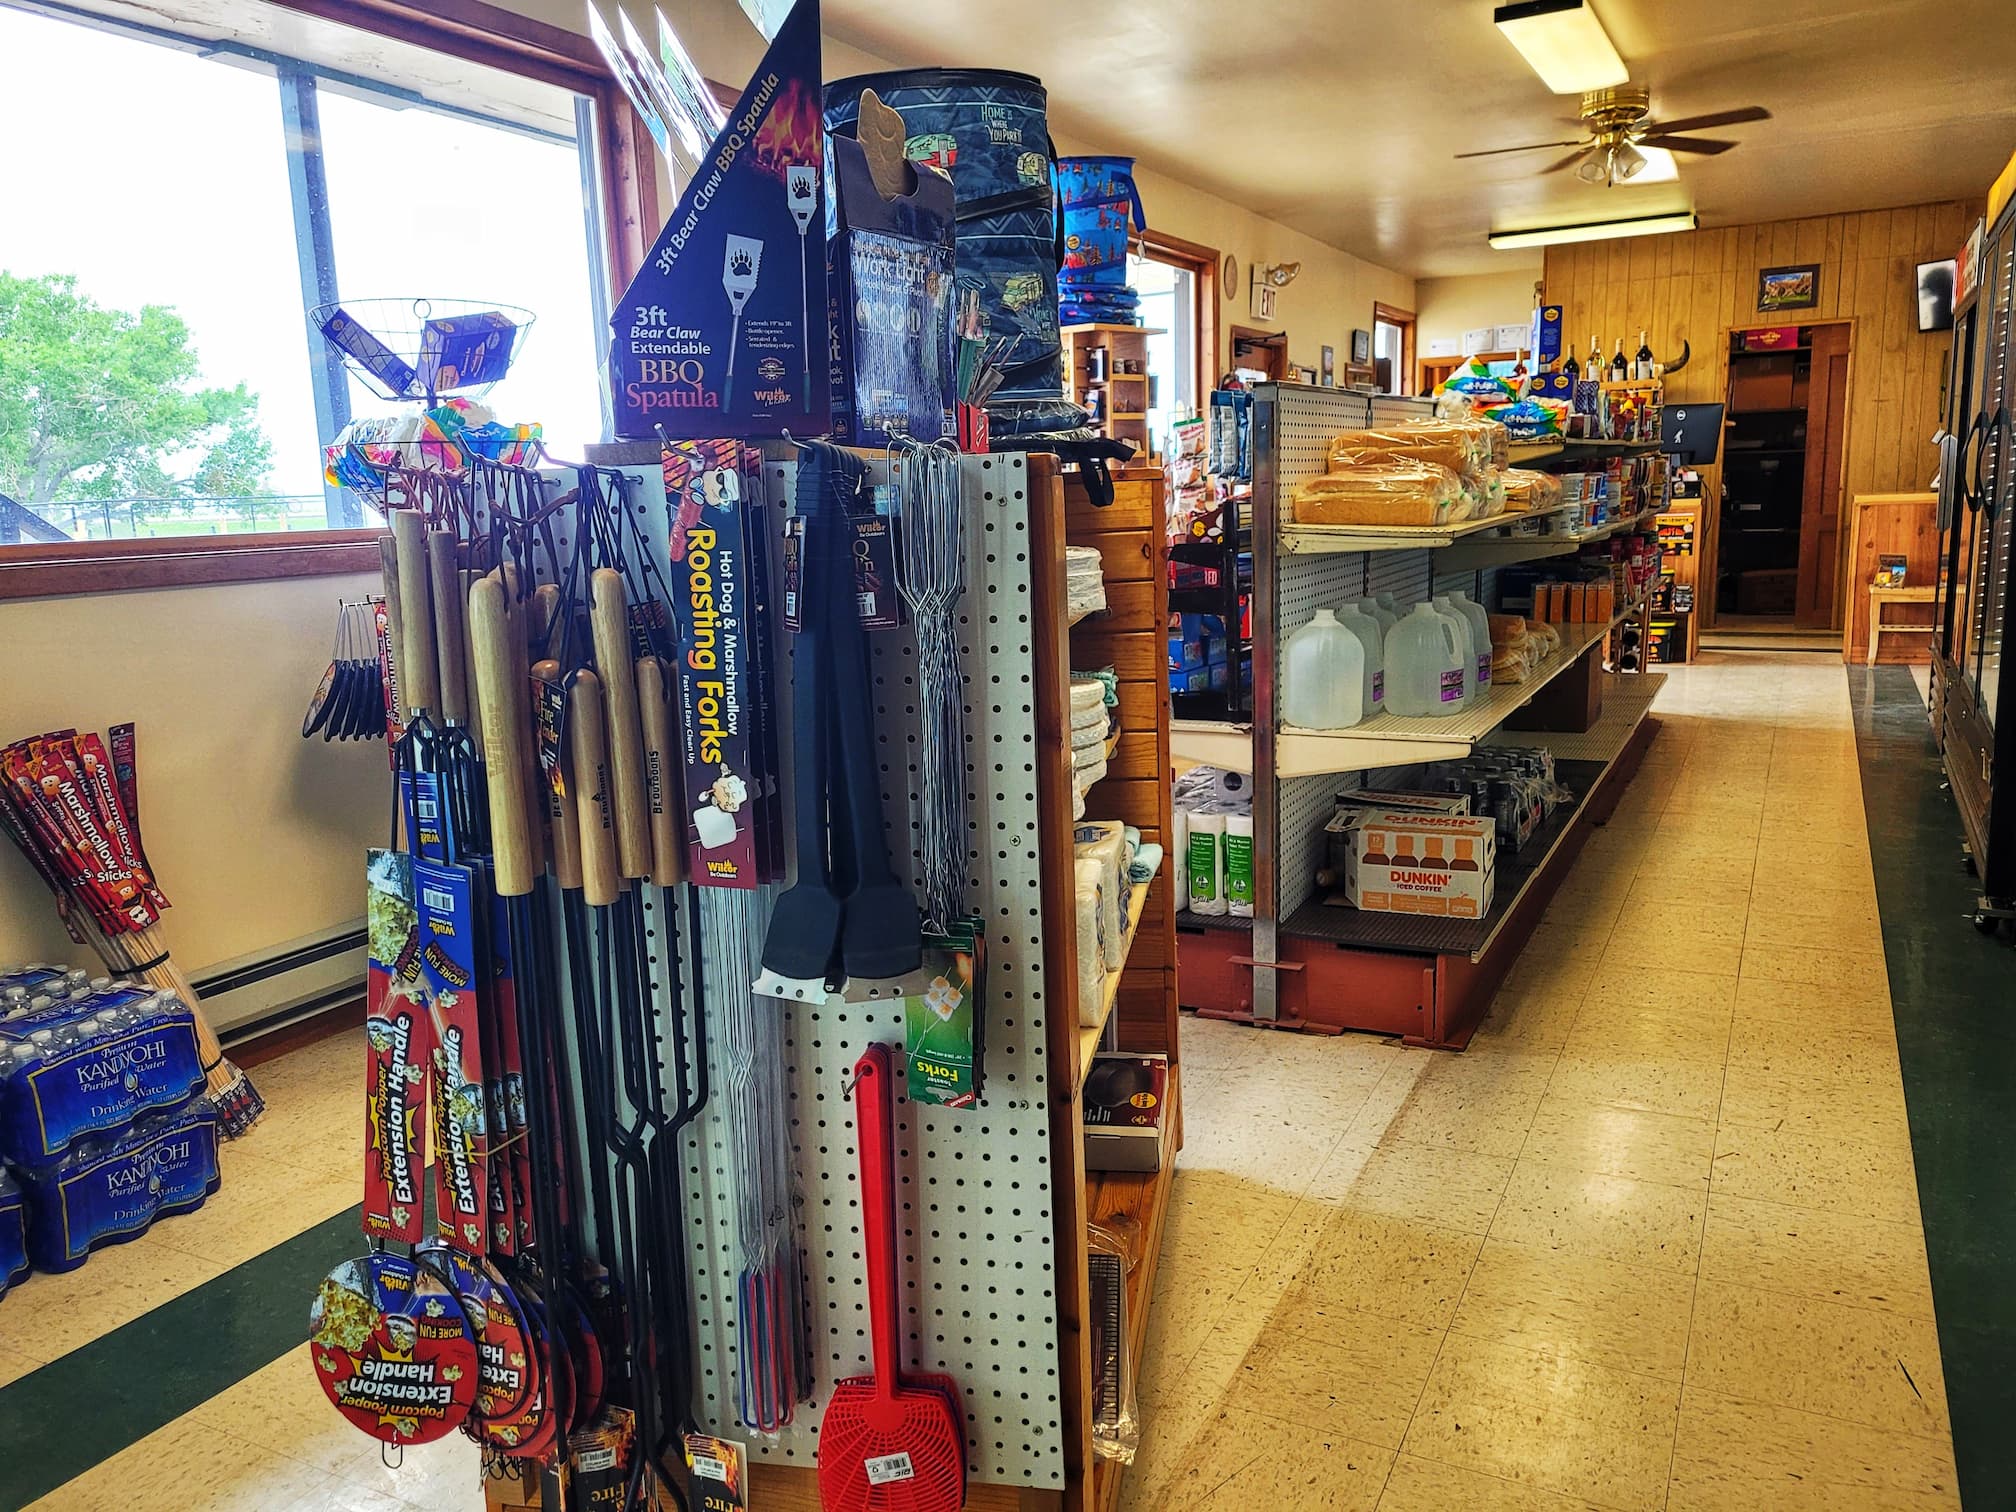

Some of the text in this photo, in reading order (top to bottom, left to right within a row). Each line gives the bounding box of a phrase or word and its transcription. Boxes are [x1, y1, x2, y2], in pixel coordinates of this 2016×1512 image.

[981, 104, 1005, 121] HOME
[991, 119, 1008, 129] WHERE
[656, 72, 779, 275] 3ft Bear Claw BBQ Spatula
[855, 255, 926, 285] Work Light
[635, 305, 668, 326] 3ft
[630, 325, 701, 340] Bear Claw
[631, 341, 711, 355] Extendable
[639, 359, 705, 388] BBQ
[626, 382, 719, 414] Spatula
[754, 388, 792, 402] Wilcor
[856, 521, 886, 533] Wilcor
[686, 529, 728, 764] Roasting Forks
[718, 550, 740, 736] Hot Dog & Marshmallow
[684, 709, 693, 728] Easy
[687, 728, 695, 752] Clean
[688, 752, 695, 765] Up
[649, 750, 663, 814] BE OUTDOORS
[95, 763, 134, 857] Marshmallow
[1384, 815, 1483, 826] DUNKIN'
[58, 780, 119, 872] Marshmallow
[97, 869, 133, 883] Sticks
[707, 859, 738, 875] Wilcor
[1390, 870, 1452, 886] DUNKIN'
[1396, 883, 1443, 893] ICED COFFEE
[403, 960, 421, 983] FUN
[424, 946, 467, 987] MORE FUN
[916, 1061, 959, 1082] Forks
[927, 1077, 953, 1088] Toaster
[81, 1074, 120, 1093] Purified
[91, 1095, 135, 1119] Drinking
[134, 1083, 168, 1099] Water
[387, 1015, 413, 1204] Extension Handle
[377, 1064, 393, 1180] Popcorn Popper
[447, 1110, 476, 1214] Extension
[114, 1196, 157, 1221] Drinking
[488, 1307, 503, 1323] FUN
[419, 1324, 463, 1338] MORE FUN
[362, 1360, 434, 1382] Handle
[349, 1377, 452, 1404] Extension
[340, 1395, 444, 1420] Popcorn Popper
[591, 1481, 626, 1503] Fire
